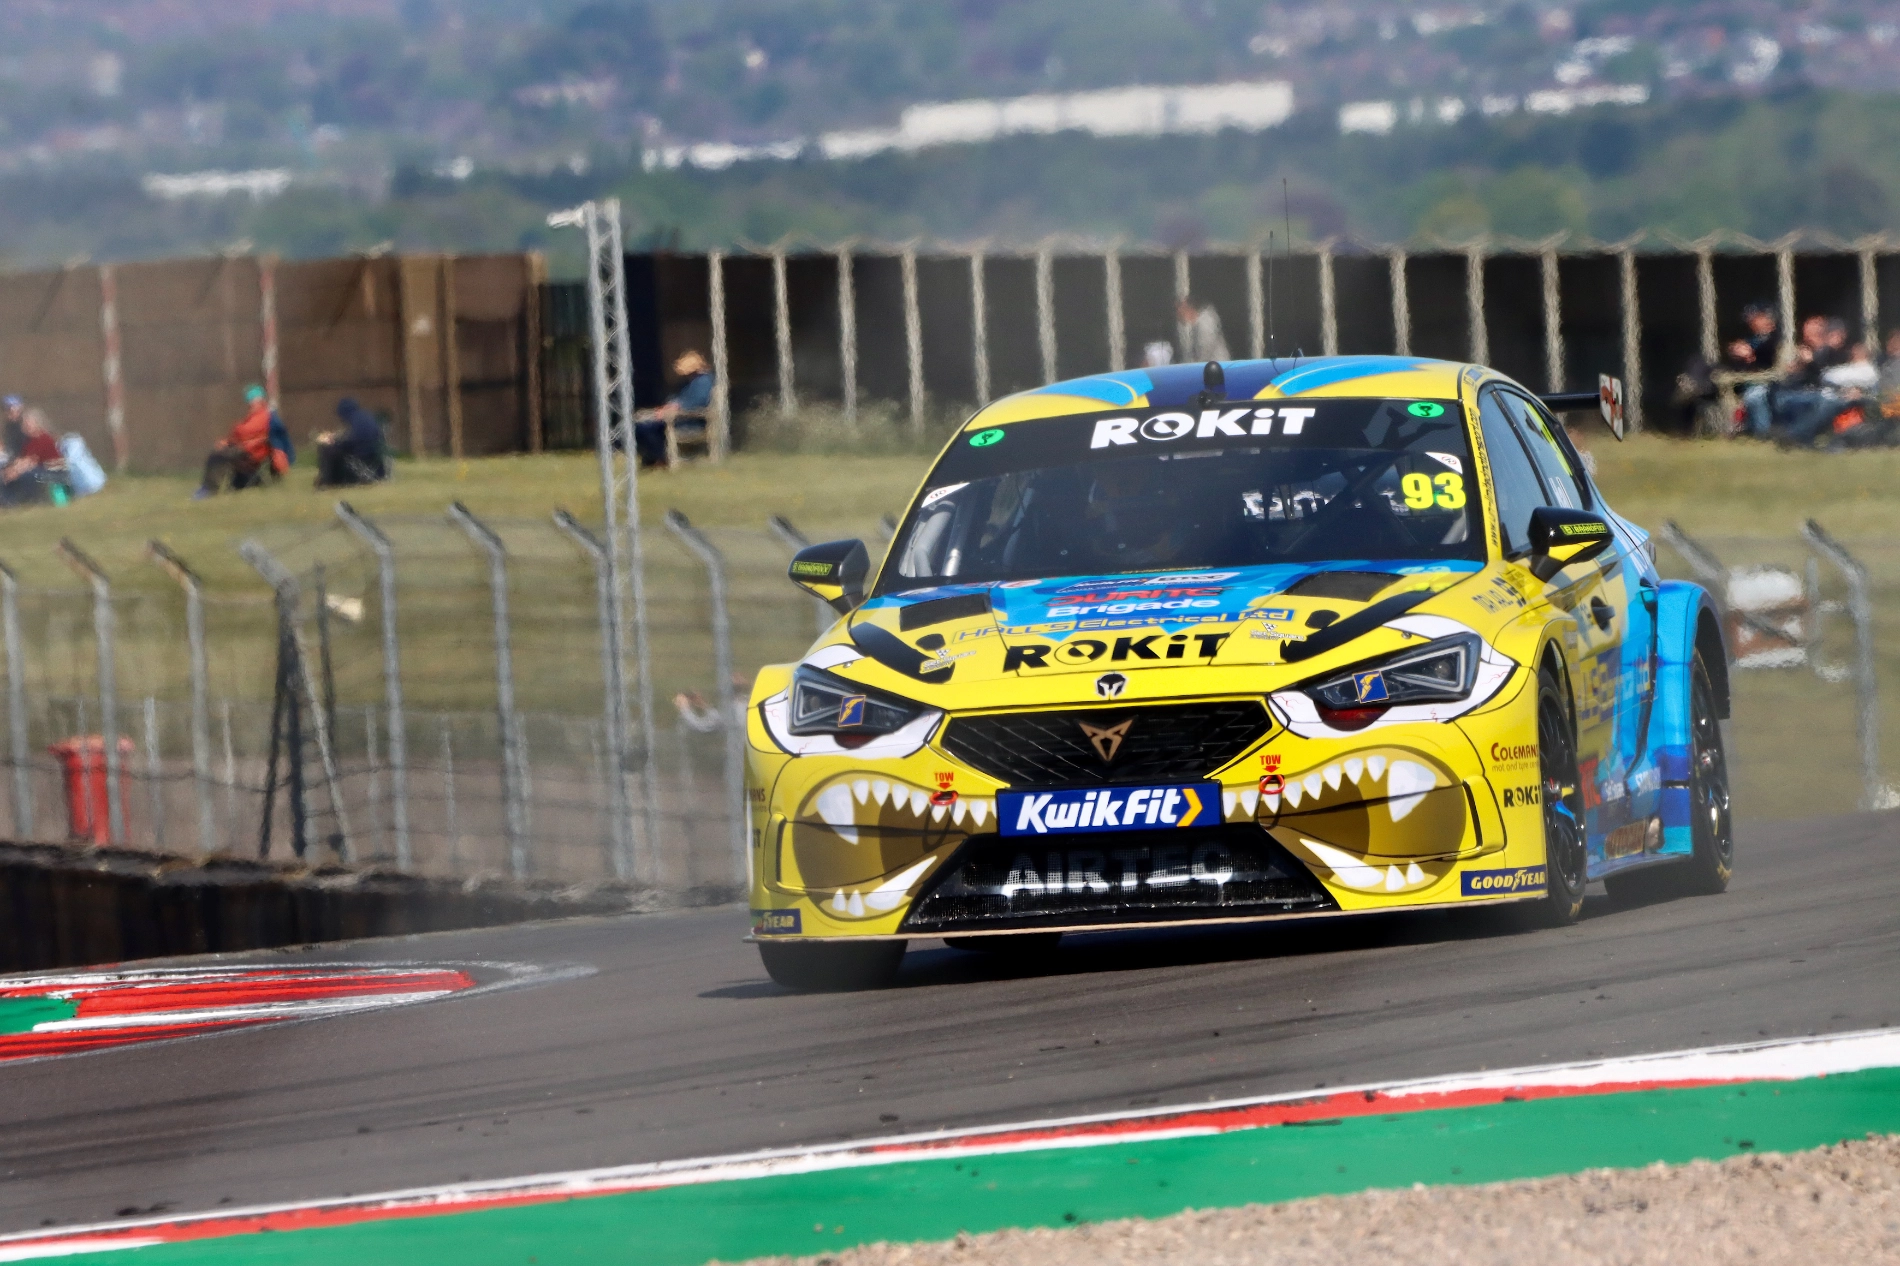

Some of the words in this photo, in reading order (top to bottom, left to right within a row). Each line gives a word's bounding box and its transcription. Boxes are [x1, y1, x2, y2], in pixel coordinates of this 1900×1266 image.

[1090, 408, 1316, 449] ROKiT
[1402, 472, 1467, 509] 93
[1046, 599, 1221, 617] Brigade
[1078, 612, 1228, 629] Electrical
[1238, 610, 1289, 620] Ltd
[1003, 632, 1230, 673] ROKiT
[1259, 754, 1282, 765] TOW
[1506, 761, 1518, 771] and
[934, 772, 954, 782] TOW
[1471, 870, 1546, 891] GOODYEAR
